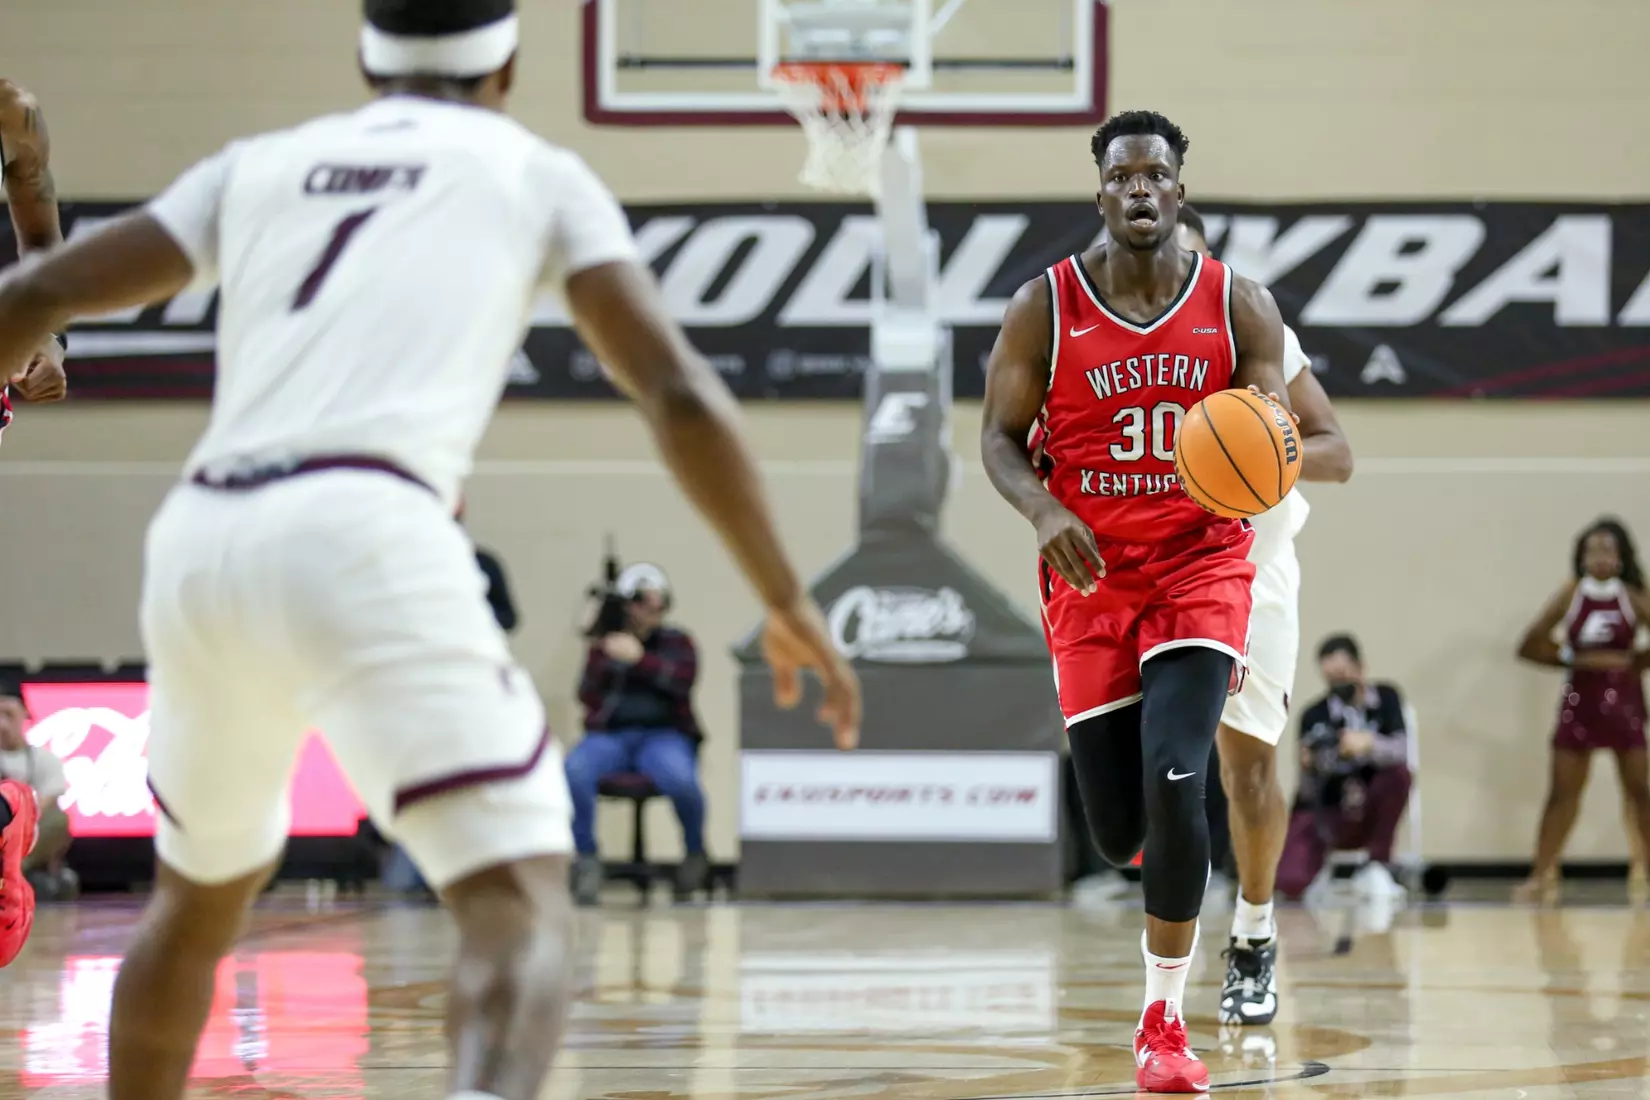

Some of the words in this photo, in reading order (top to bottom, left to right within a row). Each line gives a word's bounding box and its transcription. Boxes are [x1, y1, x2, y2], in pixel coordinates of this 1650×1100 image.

[1085, 353, 1210, 401] WESTERN
[1109, 401, 1185, 462] 30
[1080, 469, 1184, 497] KENTUC
